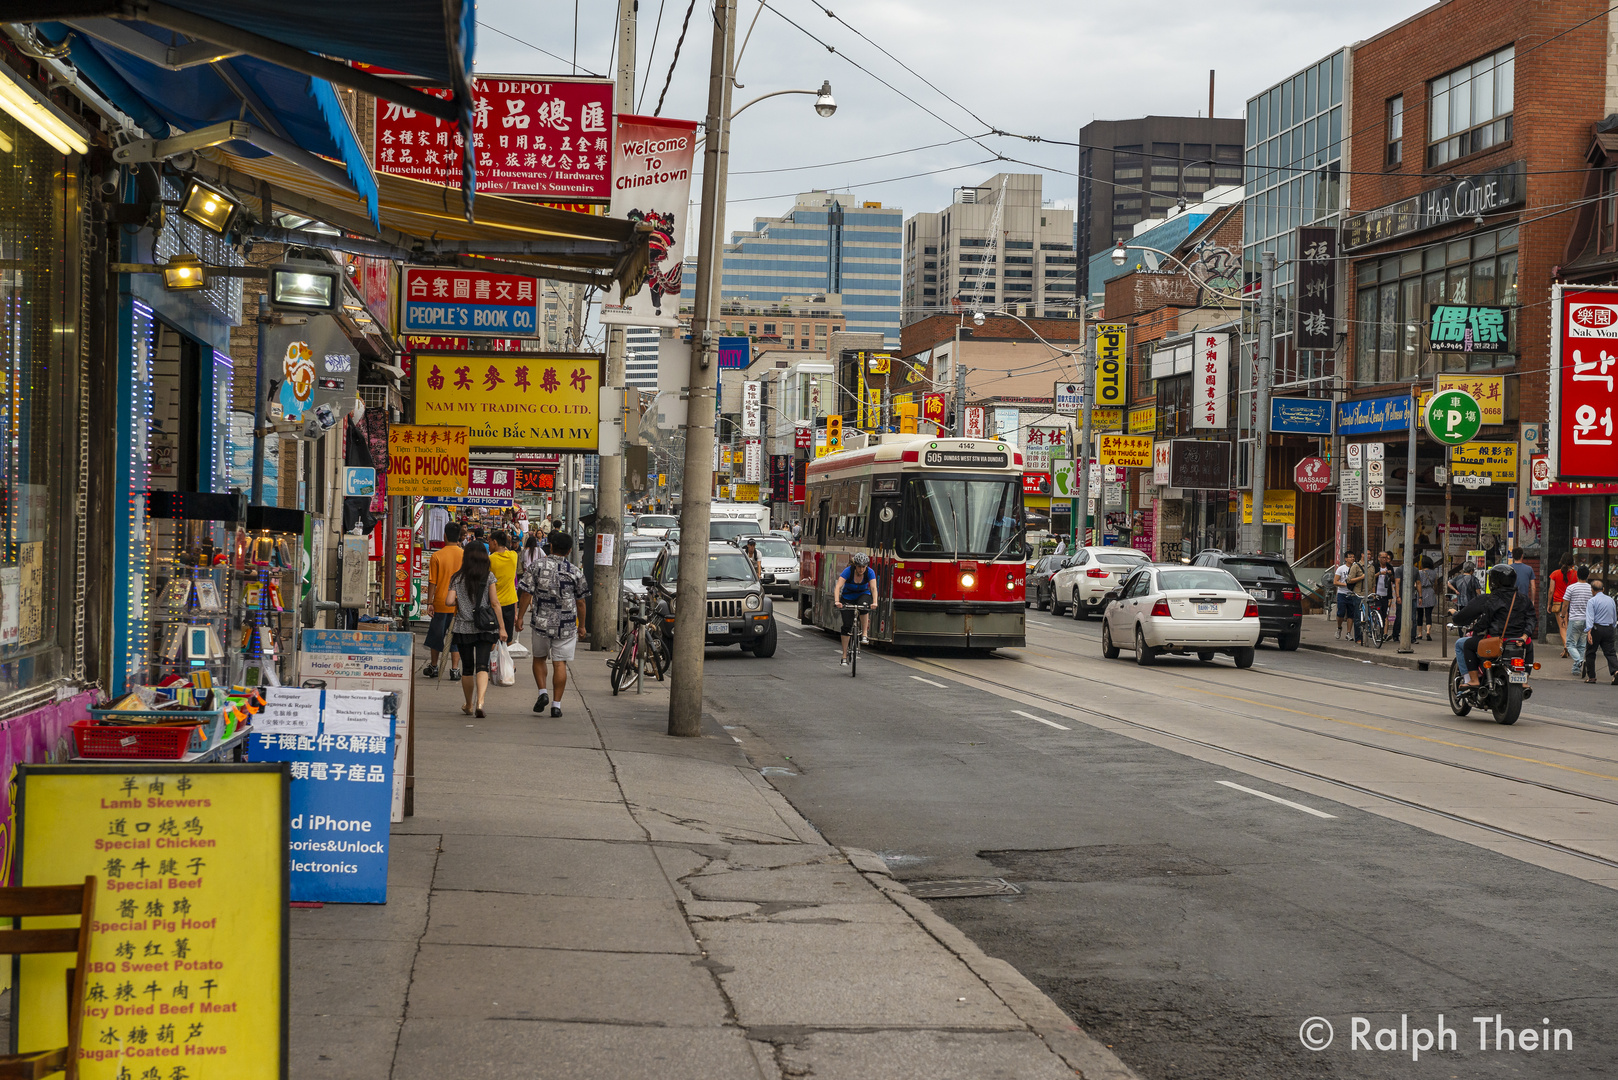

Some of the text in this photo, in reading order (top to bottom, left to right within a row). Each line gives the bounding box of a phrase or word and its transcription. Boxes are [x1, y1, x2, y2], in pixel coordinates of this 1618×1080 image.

[498, 82, 553, 95] DEPOT
[622, 137, 688, 159] Welcome
[644, 156, 663, 173] To
[381, 164, 605, 182] Household Appliaes Housewares Hardwares
[615, 168, 689, 191] Chinatown
[511, 181, 547, 191] Travel's
[549, 182, 595, 193] Souvenirs
[1426, 190, 1450, 227] HAIR
[1454, 180, 1498, 217] CULTURE
[409, 306, 533, 328] PEOPLE'S BOOK CO.
[1430, 305, 1507, 342] 偶像
[1577, 308, 1611, 326] 樂園
[1572, 328, 1592, 338] Nak
[1102, 333, 1120, 401] PHOTO
[1572, 349, 1616, 446] 낙원
[425, 401, 592, 415] NAM MY TRADING CO. LTD.
[1338, 408, 1355, 428] Oriental
[1354, 402, 1371, 425] Natural
[1370, 402, 1385, 431] Beauty
[1384, 401, 1404, 423] Wellness
[469, 421, 499, 438] huốc
[529, 427, 564, 439] NAM
[568, 428, 593, 440] MY
[958, 442, 975, 450] 4142
[1453, 446, 1515, 456] 非一般影音
[927, 453, 942, 463] 505
[943, 454, 960, 462] DUNDAS
[1460, 456, 1508, 464] Dream Music
[352, 477, 374, 486] Phone
[398, 477, 443, 486] Health Center
[1297, 476, 1328, 484] MASSAGE
[467, 487, 512, 497] ANNIE HAIR
[1306, 483, 1318, 493] $10
[896, 575, 912, 585] 4142
[1014, 578, 1024, 586] 4142
[311, 661, 332, 669] Haier
[363, 663, 404, 672] Panasonic
[333, 693, 351, 701] Iphone
[294, 702, 313, 710] Repair
[119, 775, 194, 798] 羊肉串
[100, 797, 212, 810] Lamb Skewers
[107, 816, 204, 837] 道口烧鸡
[308, 814, 372, 832] iPhone
[94, 837, 216, 852] Special Chicken
[289, 861, 359, 875] lectronics
[106, 877, 203, 893] Special Beef
[91, 917, 217, 933] Special Pig Hoof
[115, 937, 192, 959] 烤红薯
[121, 961, 170, 973] Sweet
[173, 959, 224, 971] Potato
[85, 978, 219, 1002] 麻辣牛肉干
[113, 1001, 238, 1017] Dried Beef Meat
[99, 1021, 205, 1045] 冰糖葫芦
[78, 1044, 228, 1063] Sugar-Coated Haws
